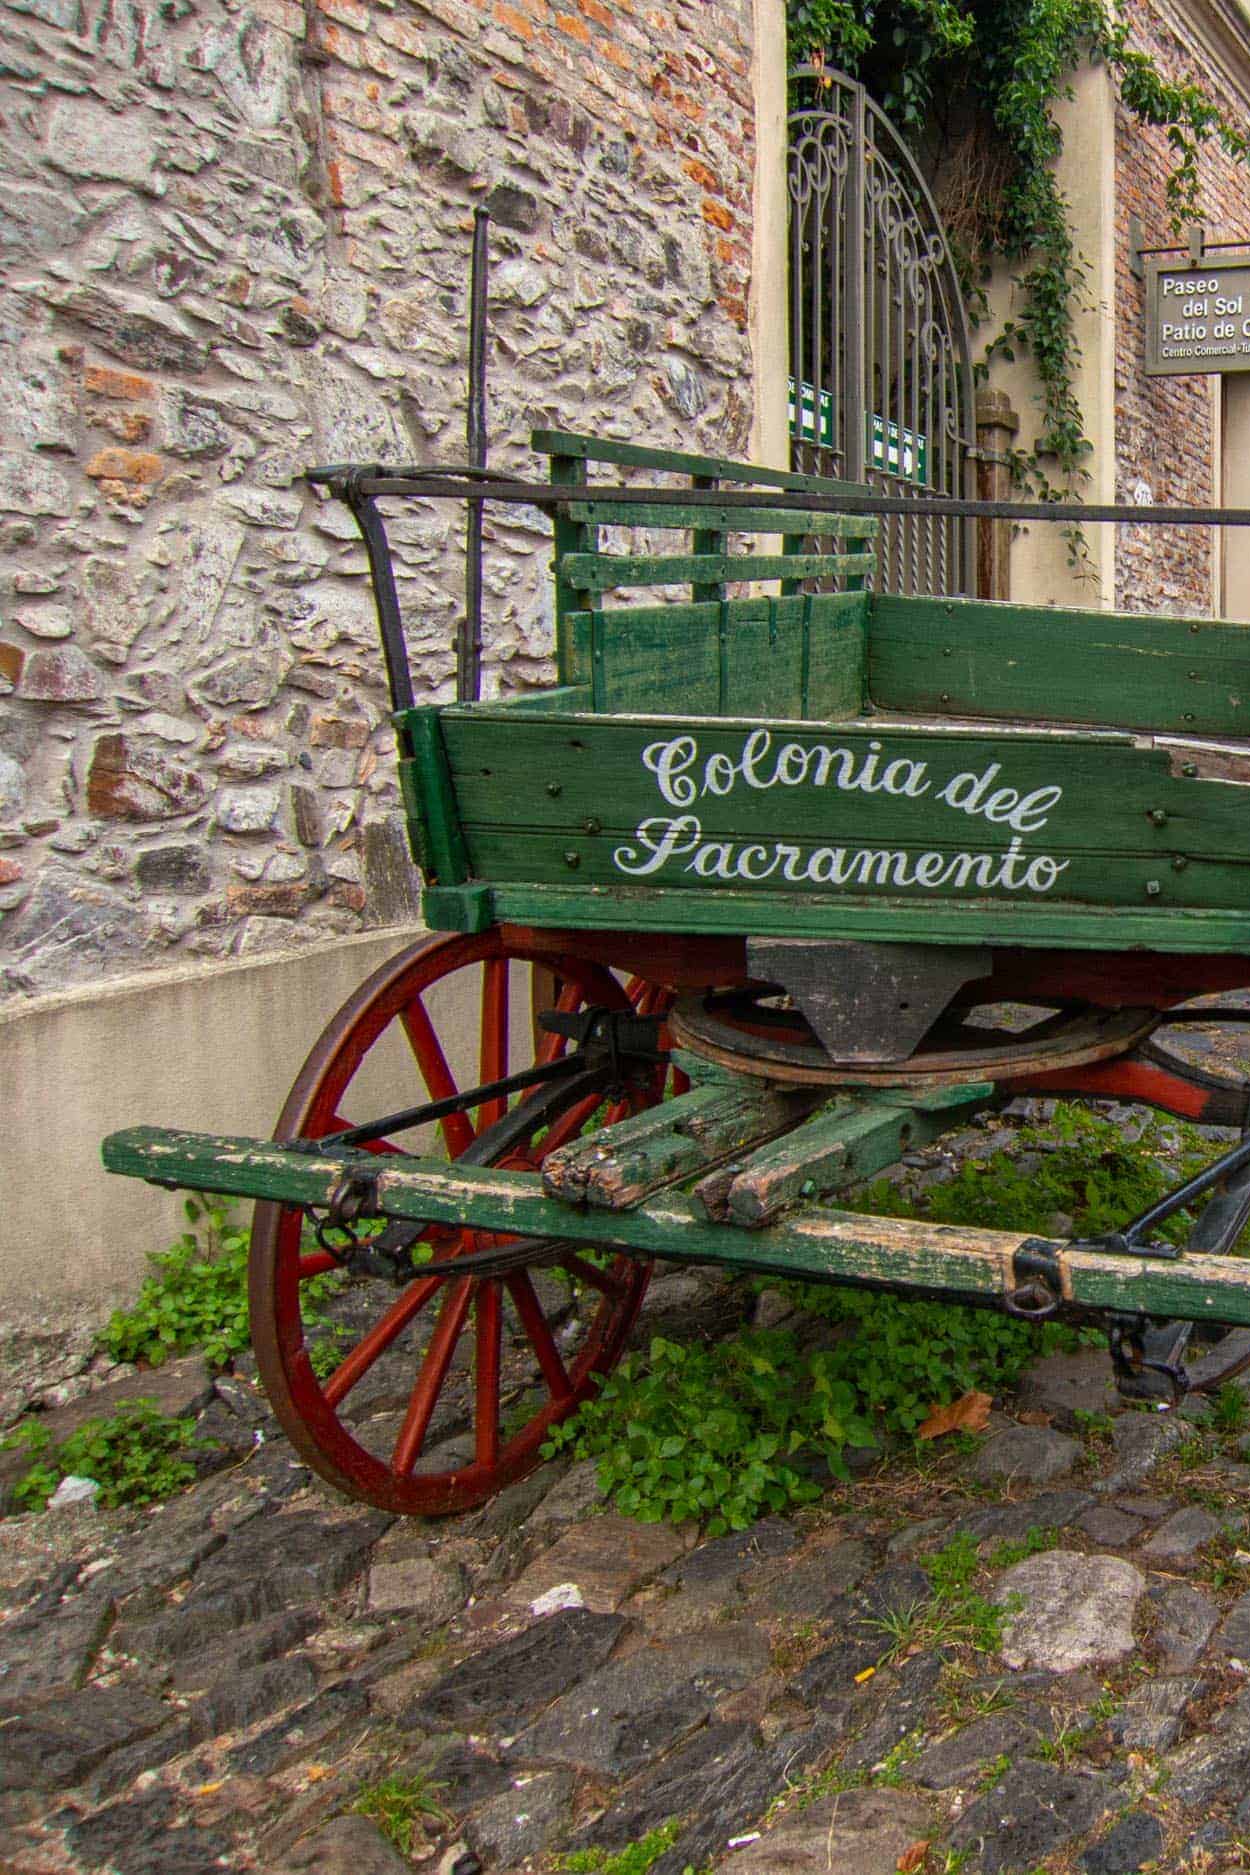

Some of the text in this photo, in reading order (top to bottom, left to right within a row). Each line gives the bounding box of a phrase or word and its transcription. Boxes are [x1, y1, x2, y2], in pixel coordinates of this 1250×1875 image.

[1163, 278, 1219, 296] Paseo
[1182, 295, 1243, 317] del Sol
[1162, 322, 1206, 341] Patio
[1214, 320, 1235, 339] de
[1162, 346, 1192, 359] Centro
[642, 728, 1063, 832] Colonia del
[613, 814, 1071, 892] Sacramento
